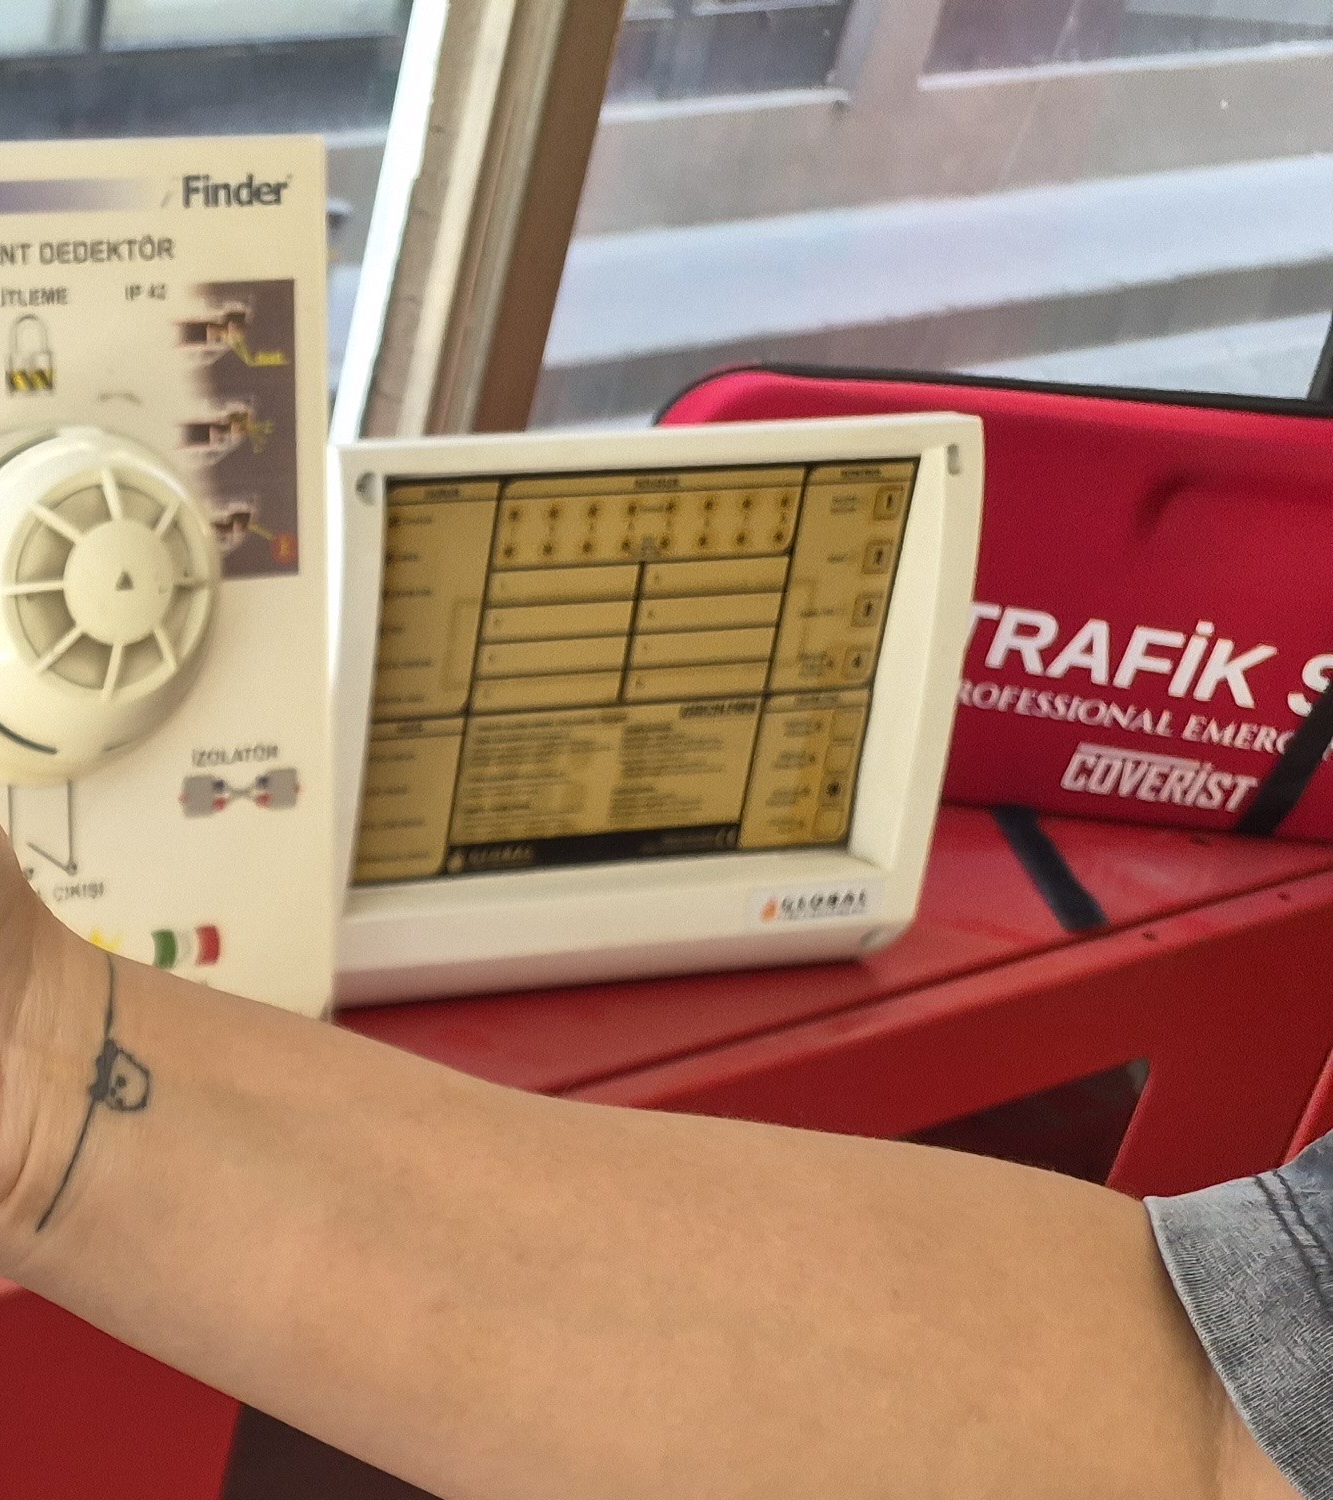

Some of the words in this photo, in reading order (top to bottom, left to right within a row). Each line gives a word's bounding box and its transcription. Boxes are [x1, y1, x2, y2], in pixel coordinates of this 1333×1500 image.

[182, 173, 288, 210] Finder
[39, 233, 176, 265] DEDEKTÖR
[957, 679, 1173, 738] ROFESSIONAL
